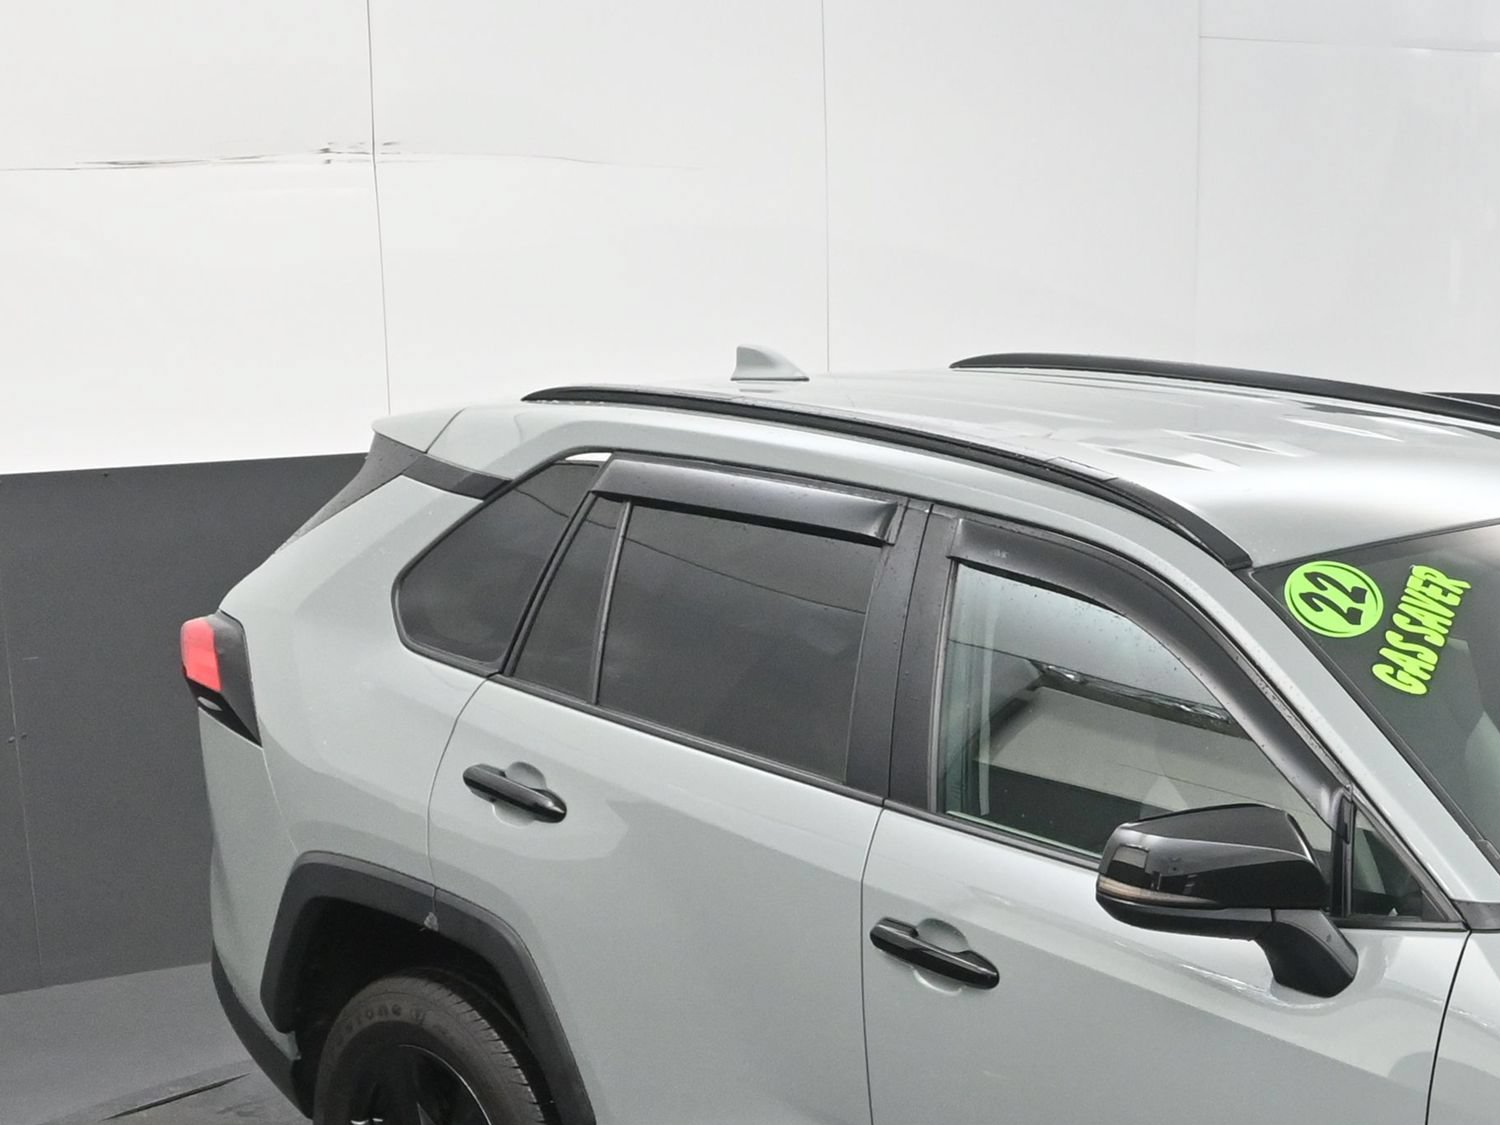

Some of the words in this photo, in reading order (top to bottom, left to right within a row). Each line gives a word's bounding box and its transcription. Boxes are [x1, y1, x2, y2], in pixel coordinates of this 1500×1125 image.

[1299, 571, 1368, 625] 22
[1392, 564, 1472, 648] SAVER
[1372, 630, 1439, 695] GAS
